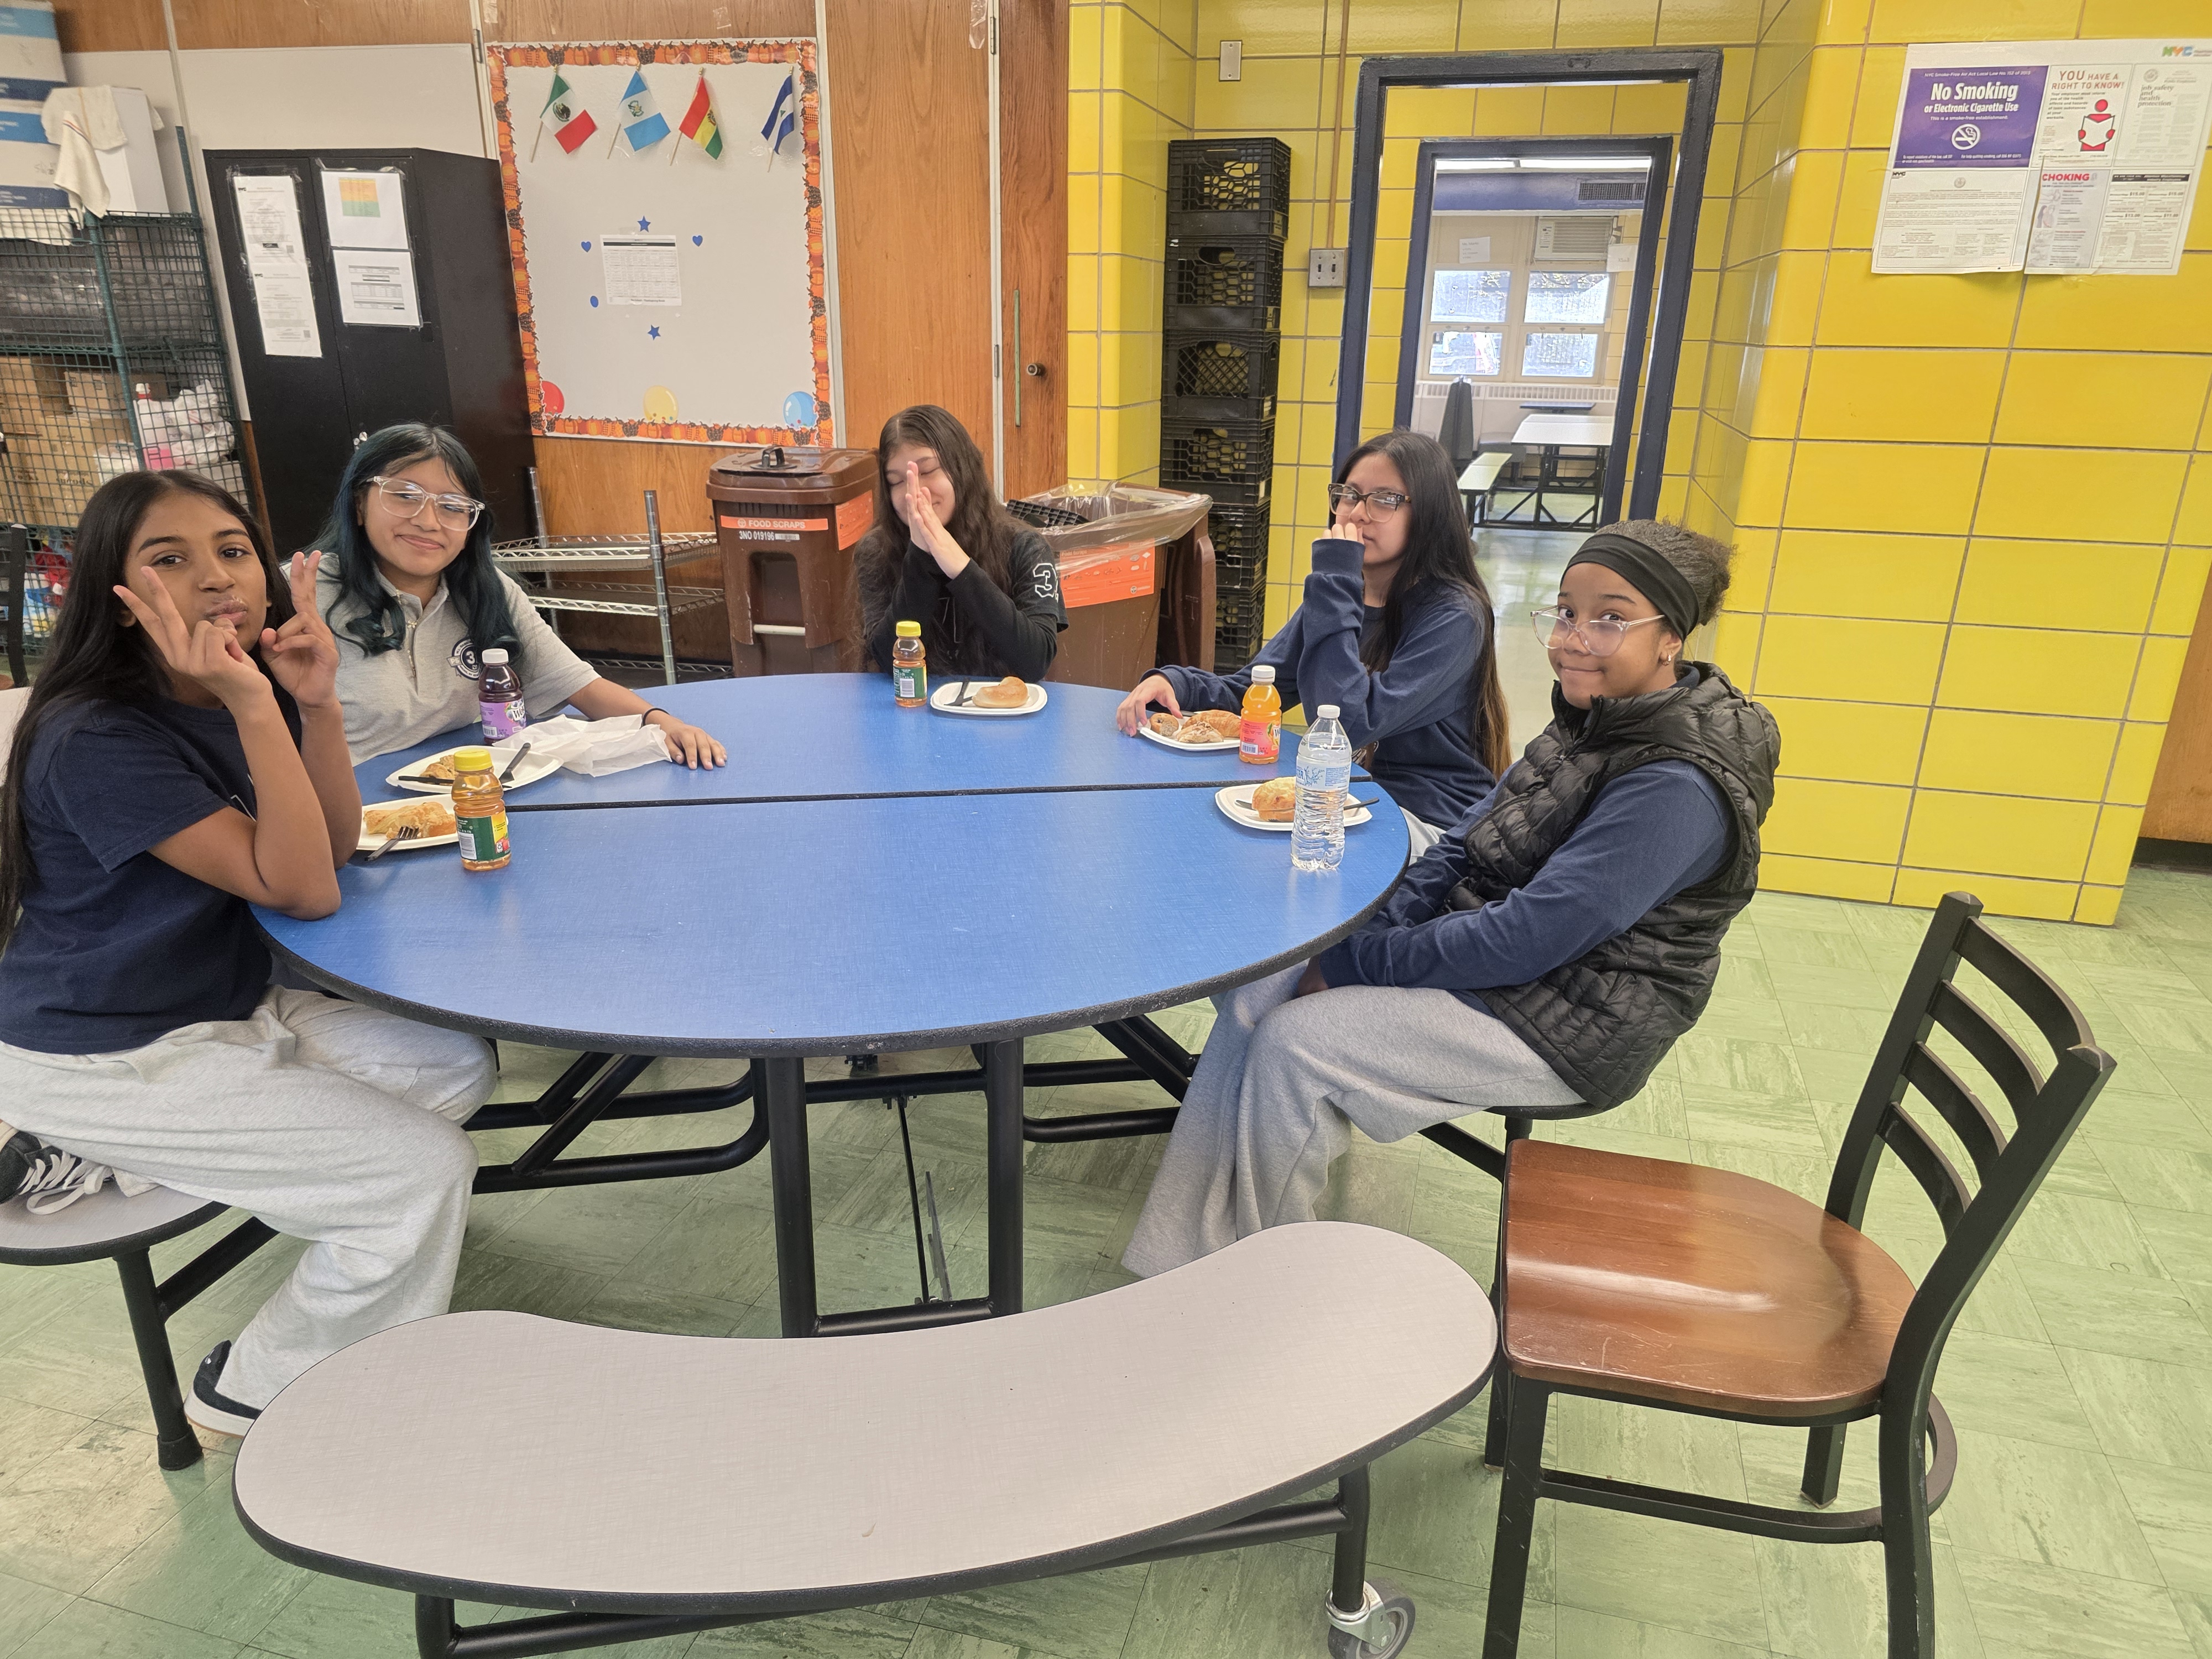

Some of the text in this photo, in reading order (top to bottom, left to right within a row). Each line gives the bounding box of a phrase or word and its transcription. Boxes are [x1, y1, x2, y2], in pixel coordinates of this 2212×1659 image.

[2059, 70, 2085, 81] YOU
[1931, 81, 2019, 102] No Smoking
[2153, 84, 2174, 92] safety
[1924, 102, 2019, 113] or Electronic Cigarette Use
[2042, 173, 2090, 181] CHOKING
[748, 519, 806, 529] FOOD SCRAPS
[739, 530, 775, 541] 3NO 019196
